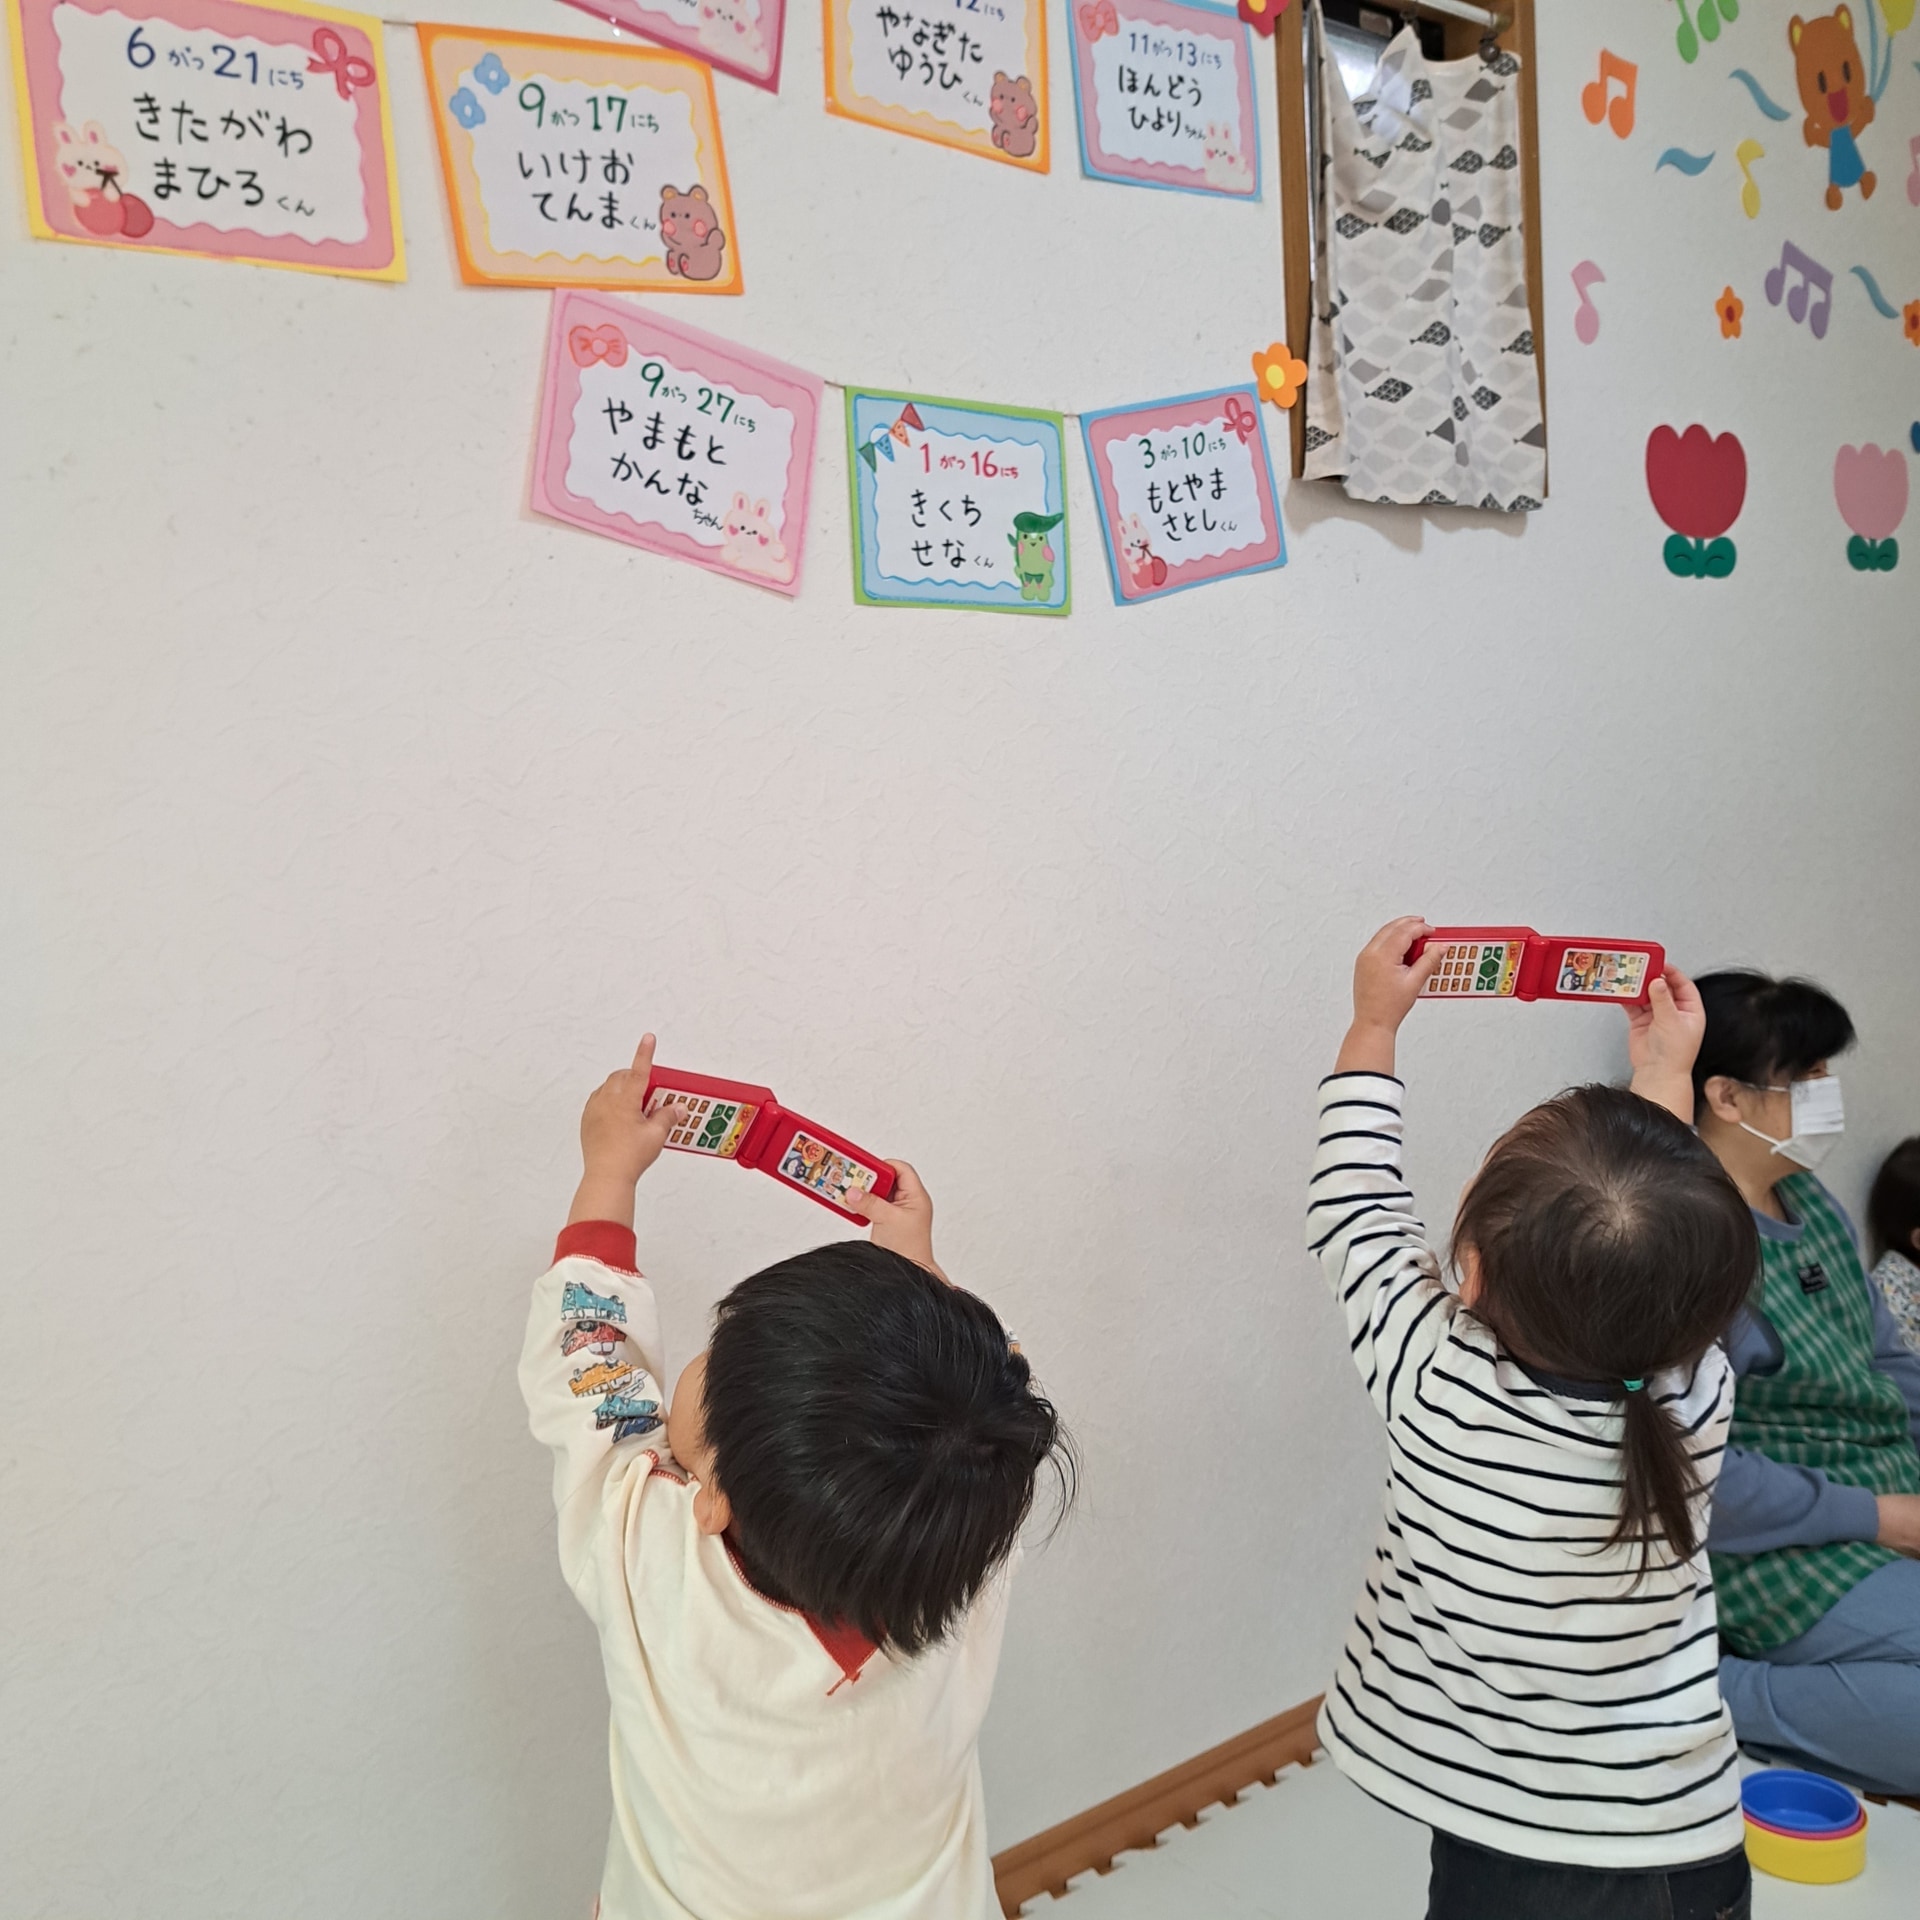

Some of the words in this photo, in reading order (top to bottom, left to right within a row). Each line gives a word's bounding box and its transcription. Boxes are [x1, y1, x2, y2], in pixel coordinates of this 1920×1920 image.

[876, 5, 984, 63] やなぎた
[887, 44, 984, 107] ゆうひくん
[1118, 64, 1202, 107] ほんどう
[133, 92, 313, 158] きたがわ
[1127, 105, 1207, 140] ひよりちゃん
[153, 157, 315, 217] まひろくん
[518, 148, 635, 185] いけお
[531, 191, 656, 231] てんまくん
[601, 396, 727, 466] やまもと
[910, 488, 983, 528] きくち
[1146, 467, 1228, 514] もとやま
[1161, 508, 1238, 542] さとしくん
[910, 538, 995, 569] せなくん
